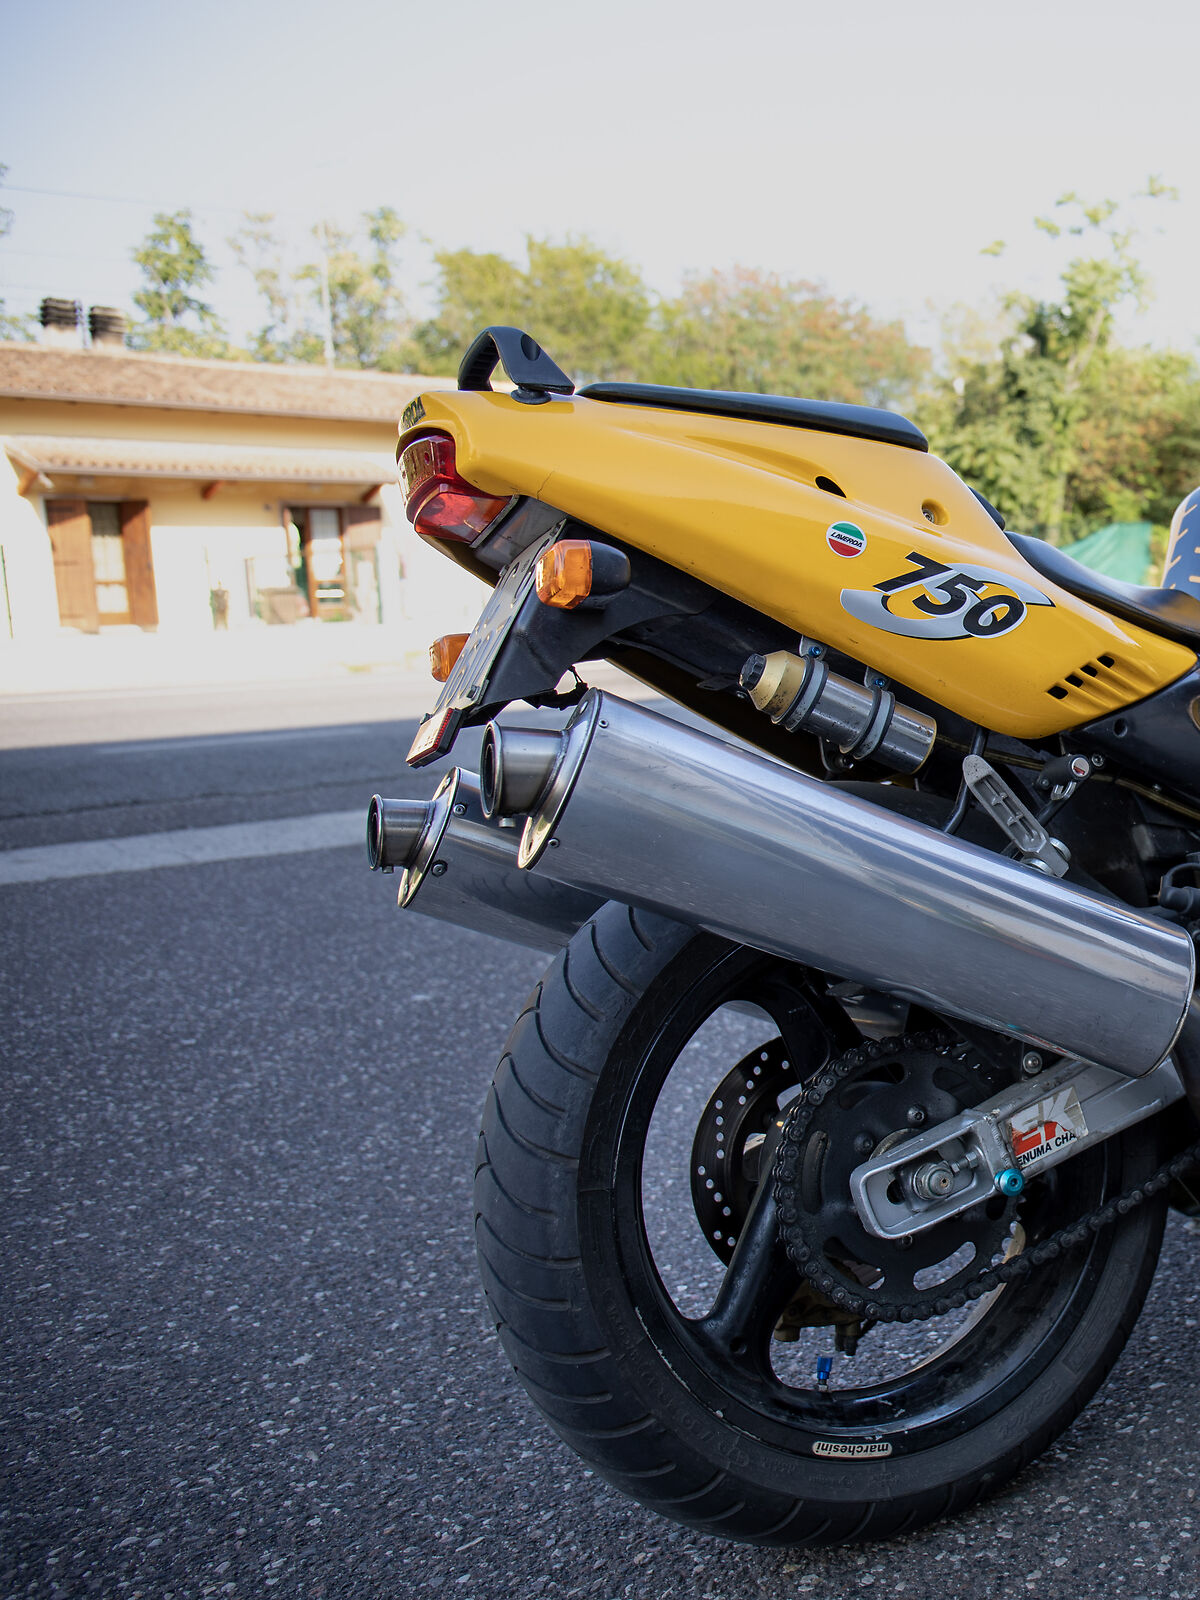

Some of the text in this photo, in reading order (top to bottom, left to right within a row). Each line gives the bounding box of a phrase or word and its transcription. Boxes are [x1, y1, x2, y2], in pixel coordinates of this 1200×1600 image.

[831, 531, 863, 548] LAVERDA
[873, 551, 1027, 638] 750
[816, 1442, 888, 1456] marchesini
